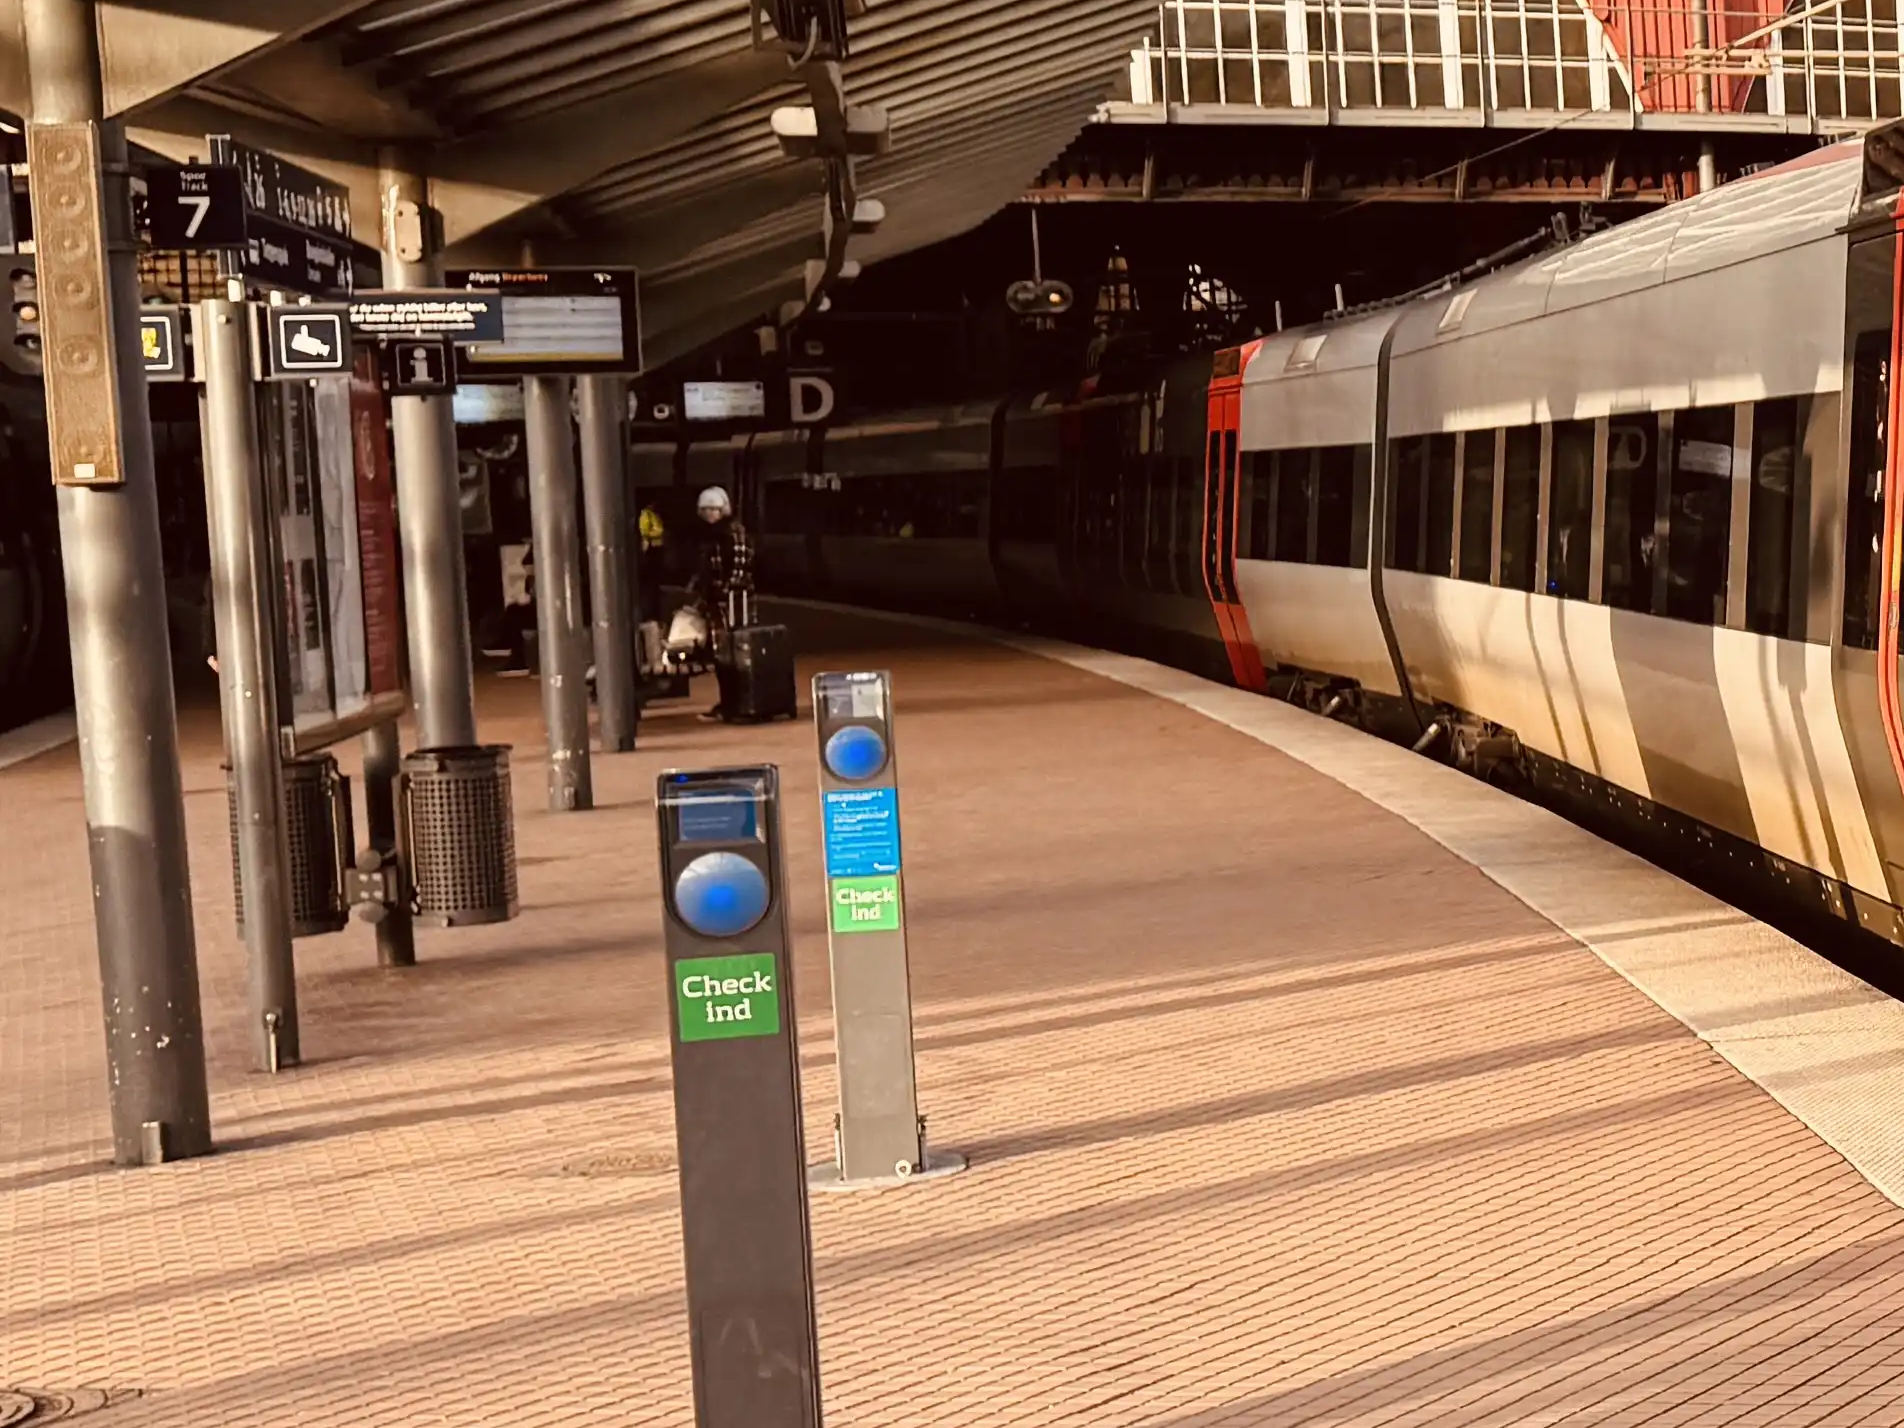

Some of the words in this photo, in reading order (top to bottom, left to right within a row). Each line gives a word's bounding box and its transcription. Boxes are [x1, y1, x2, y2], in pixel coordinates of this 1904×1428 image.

[178, 195, 210, 238] 7
[790, 376, 834, 422] D
[835, 886, 896, 906] Check
[851, 904, 882, 922] ind
[682, 971, 773, 999] Check
[705, 997, 753, 1023] ind
